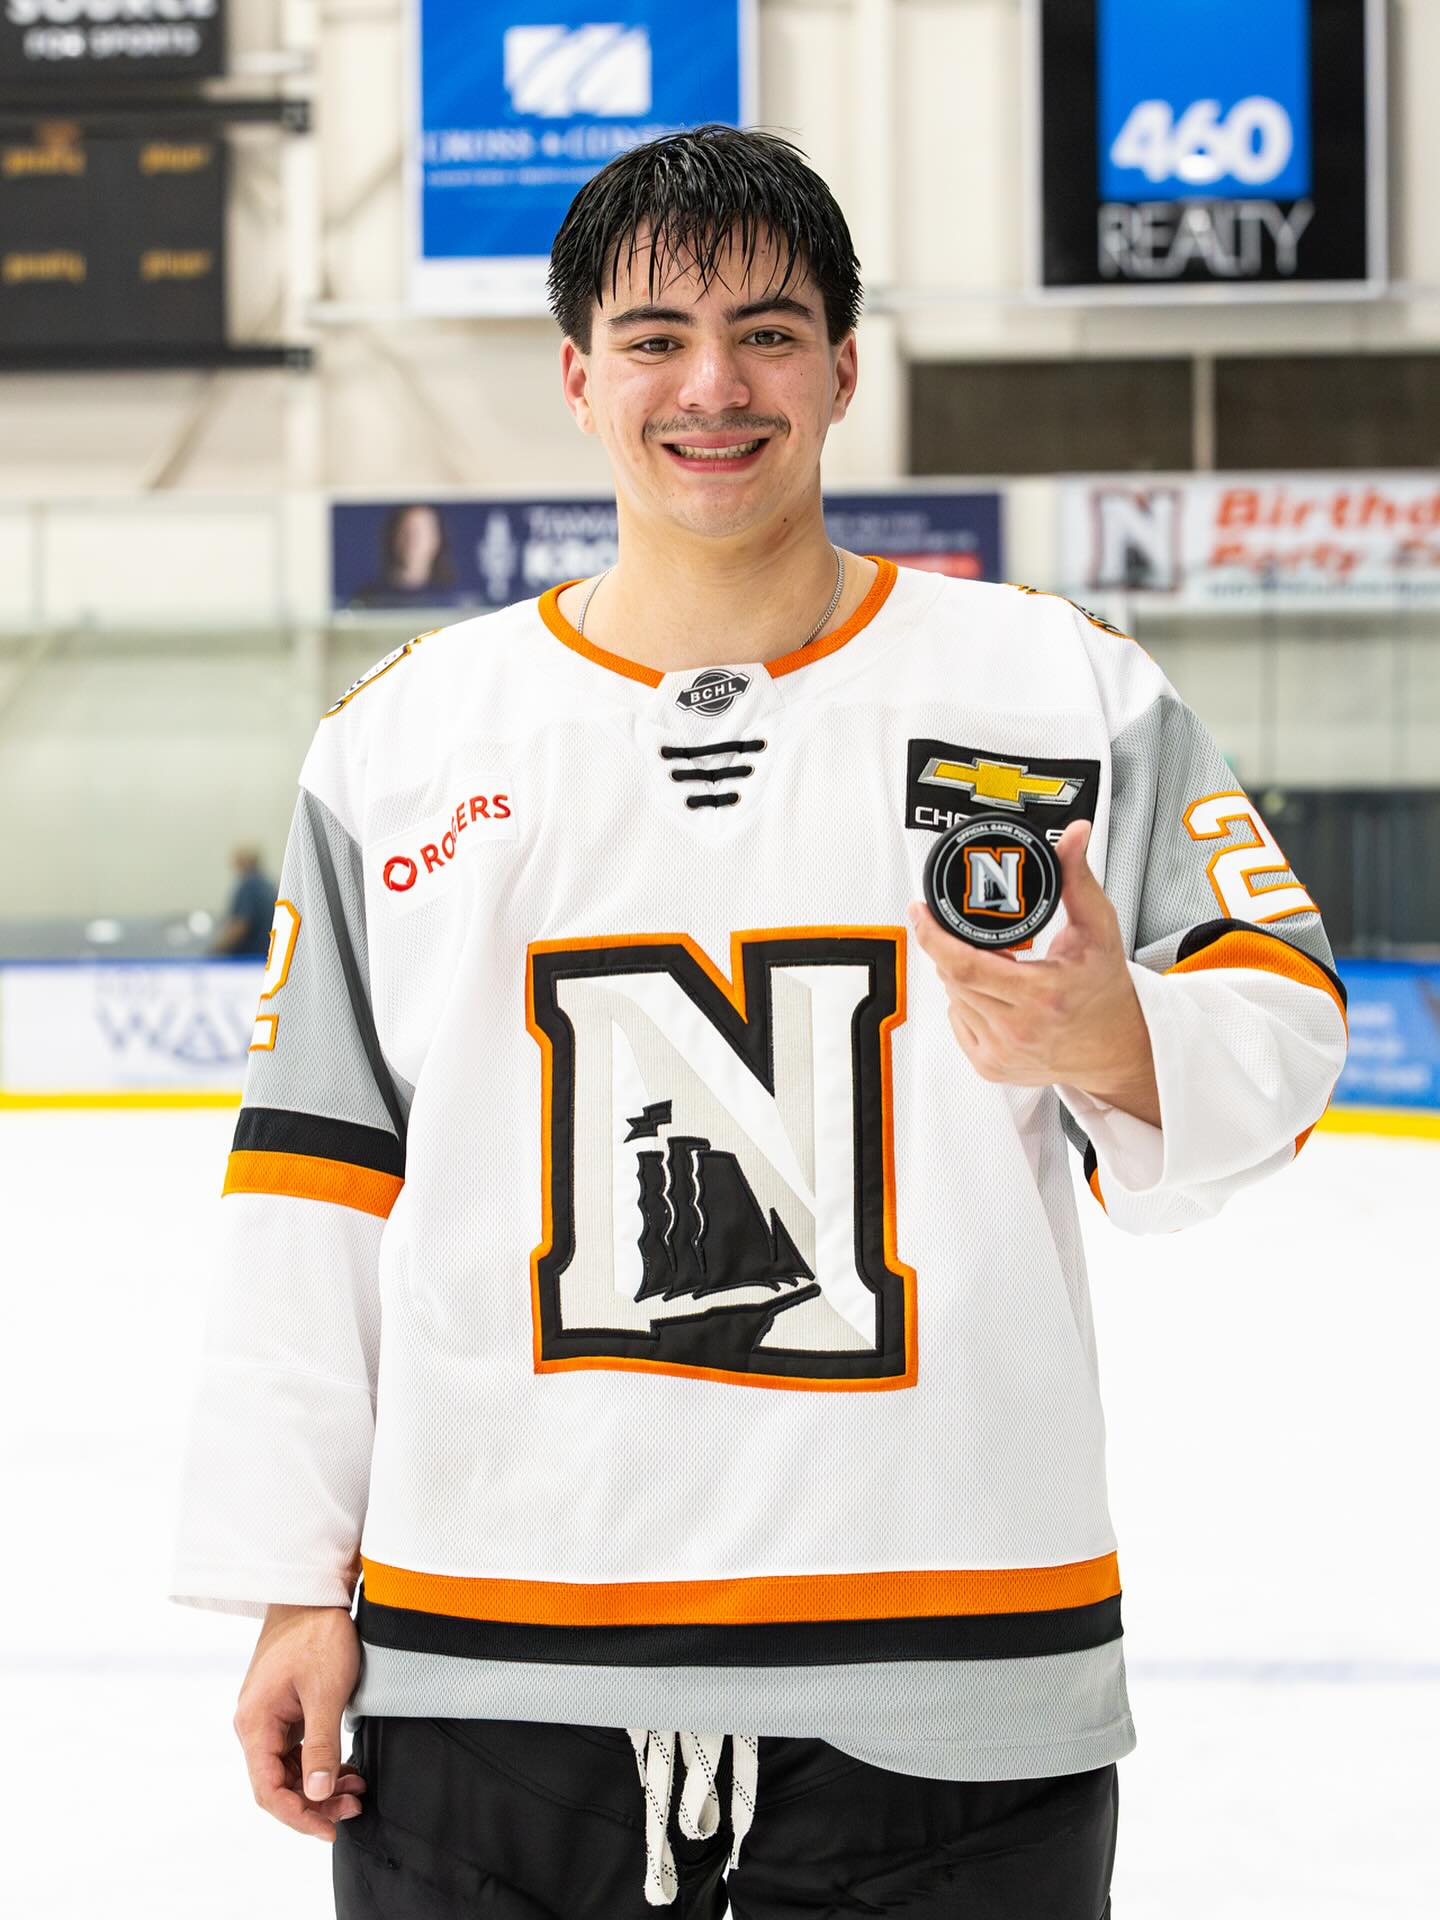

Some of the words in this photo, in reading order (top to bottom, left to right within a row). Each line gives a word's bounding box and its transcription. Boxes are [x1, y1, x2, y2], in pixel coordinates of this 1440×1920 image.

[1110, 95, 1293, 185] 460
[1098, 198, 1315, 278] REALTY
[690, 681, 737, 704] BCHL
[956, 824, 990, 843] OFFICIAL
[990, 823, 1014, 833] GAME
[1014, 828, 1033, 844] PUCK
[963, 847, 1025, 918] N
[959, 923, 998, 940] COLUMBIA
[998, 924, 1029, 940] HOCKEY
[1028, 898, 1049, 927] LEAGUE
[526, 926, 918, 1392] N
